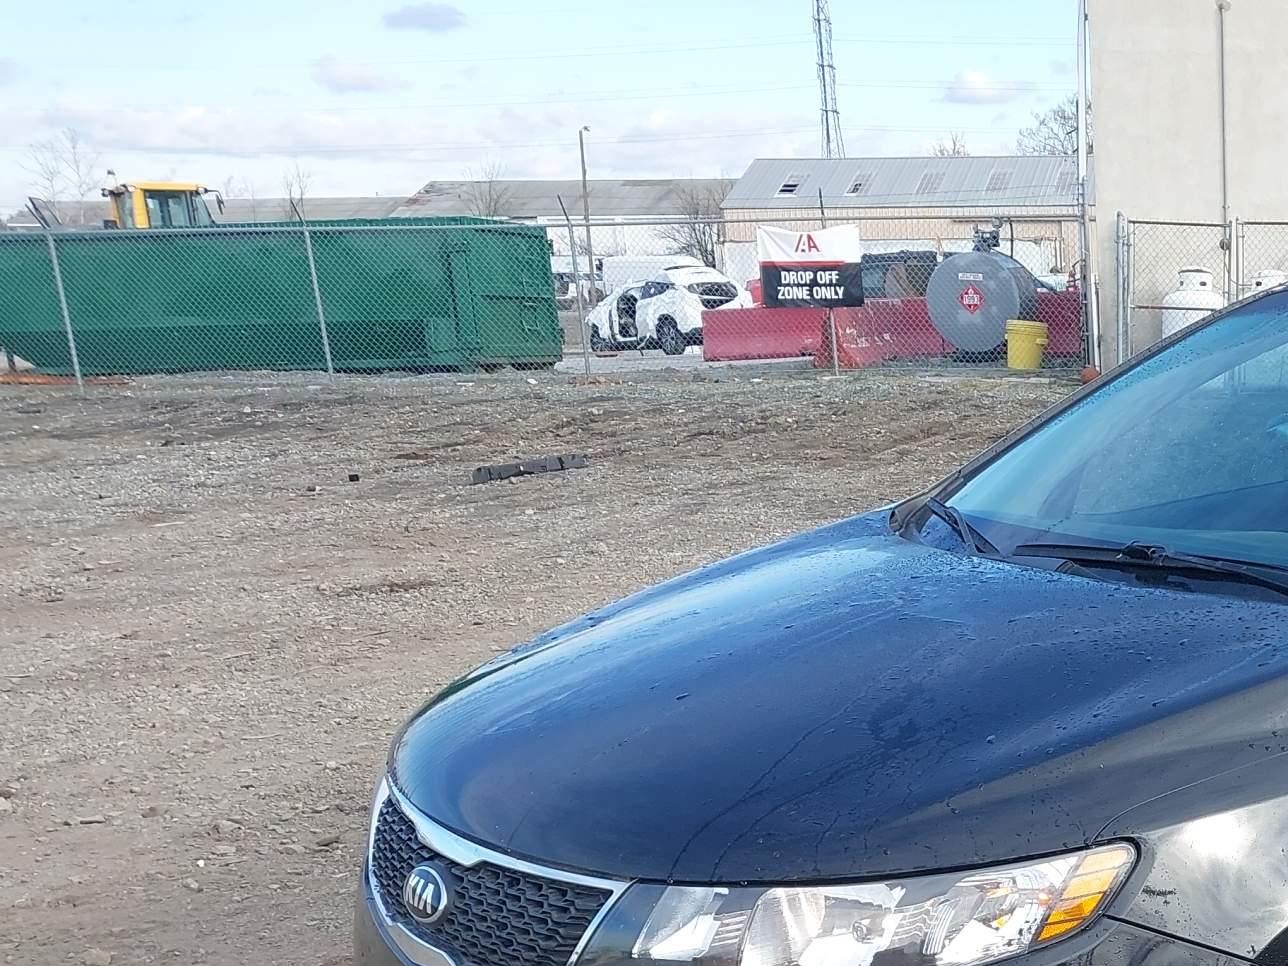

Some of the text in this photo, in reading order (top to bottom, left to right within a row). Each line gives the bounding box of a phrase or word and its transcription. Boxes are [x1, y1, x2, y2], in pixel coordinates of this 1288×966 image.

[781, 271, 839, 284] DROP OFF
[778, 286, 844, 299] ZONE ONLY
[405, 873, 435, 914] KIA
